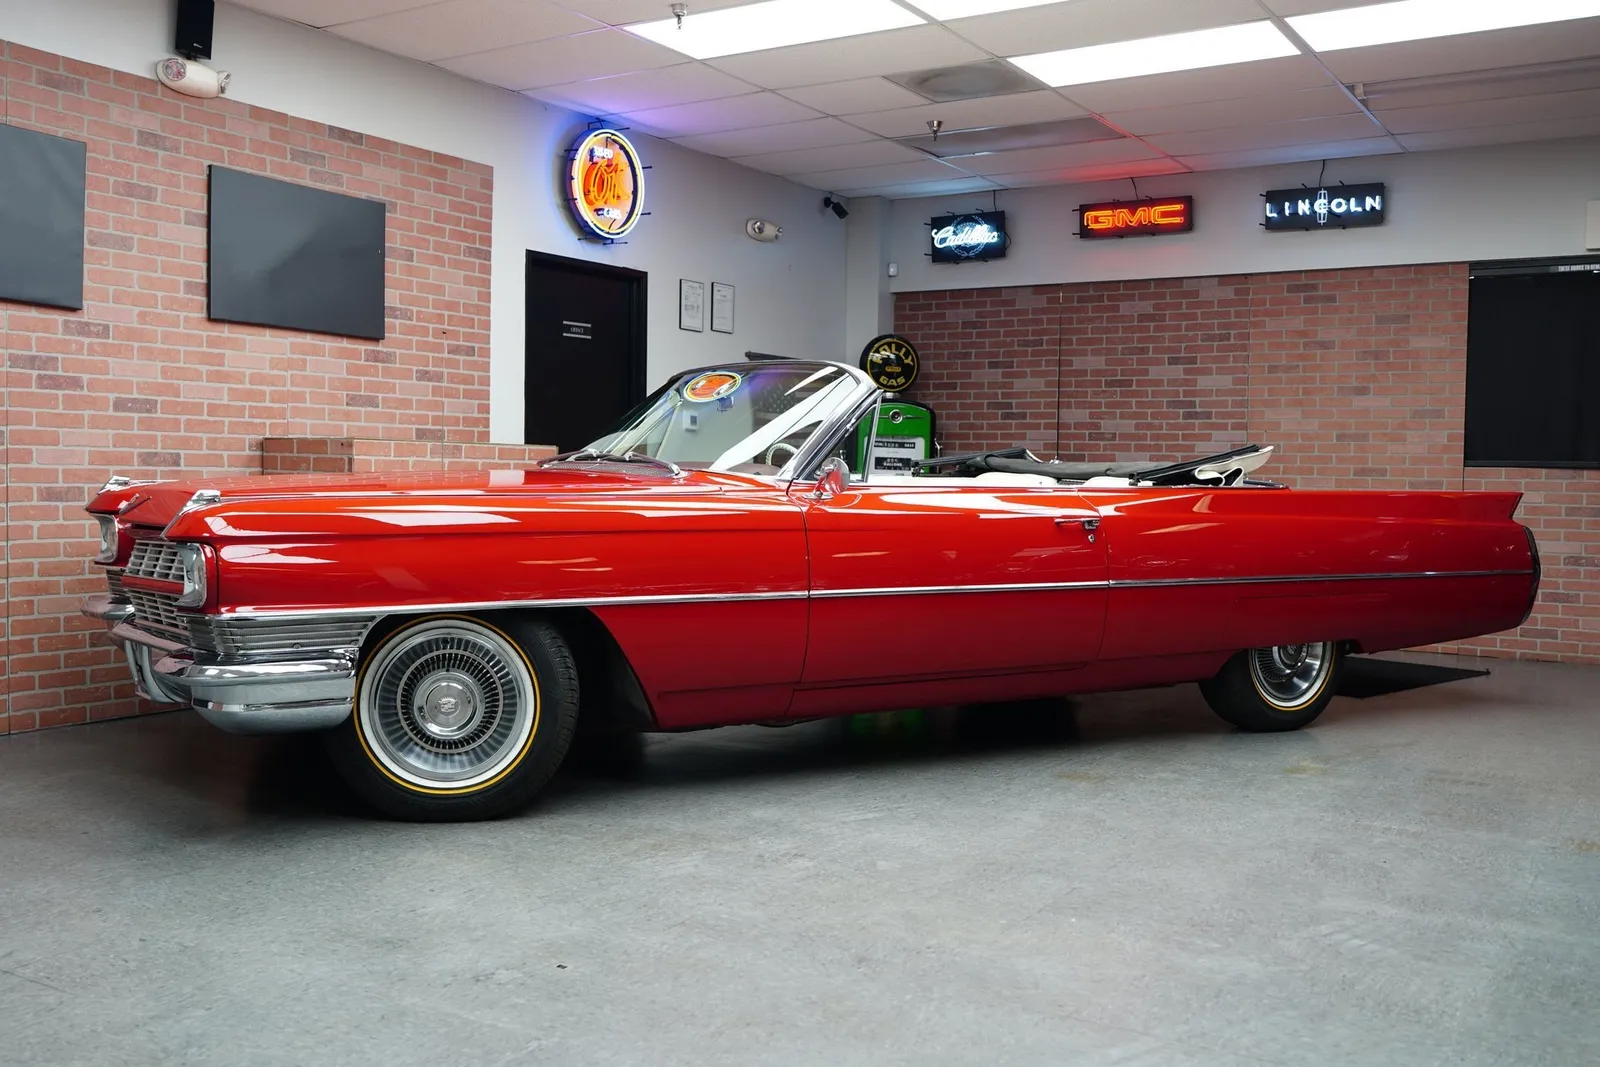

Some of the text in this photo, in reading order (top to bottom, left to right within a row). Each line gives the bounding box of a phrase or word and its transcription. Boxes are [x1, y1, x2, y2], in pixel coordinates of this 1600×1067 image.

[1084, 204, 1184, 229] GMC
[1265, 195, 1382, 217] LINCOLN
[931, 223, 1000, 248] Cadillac
[879, 375, 906, 386] GAS
